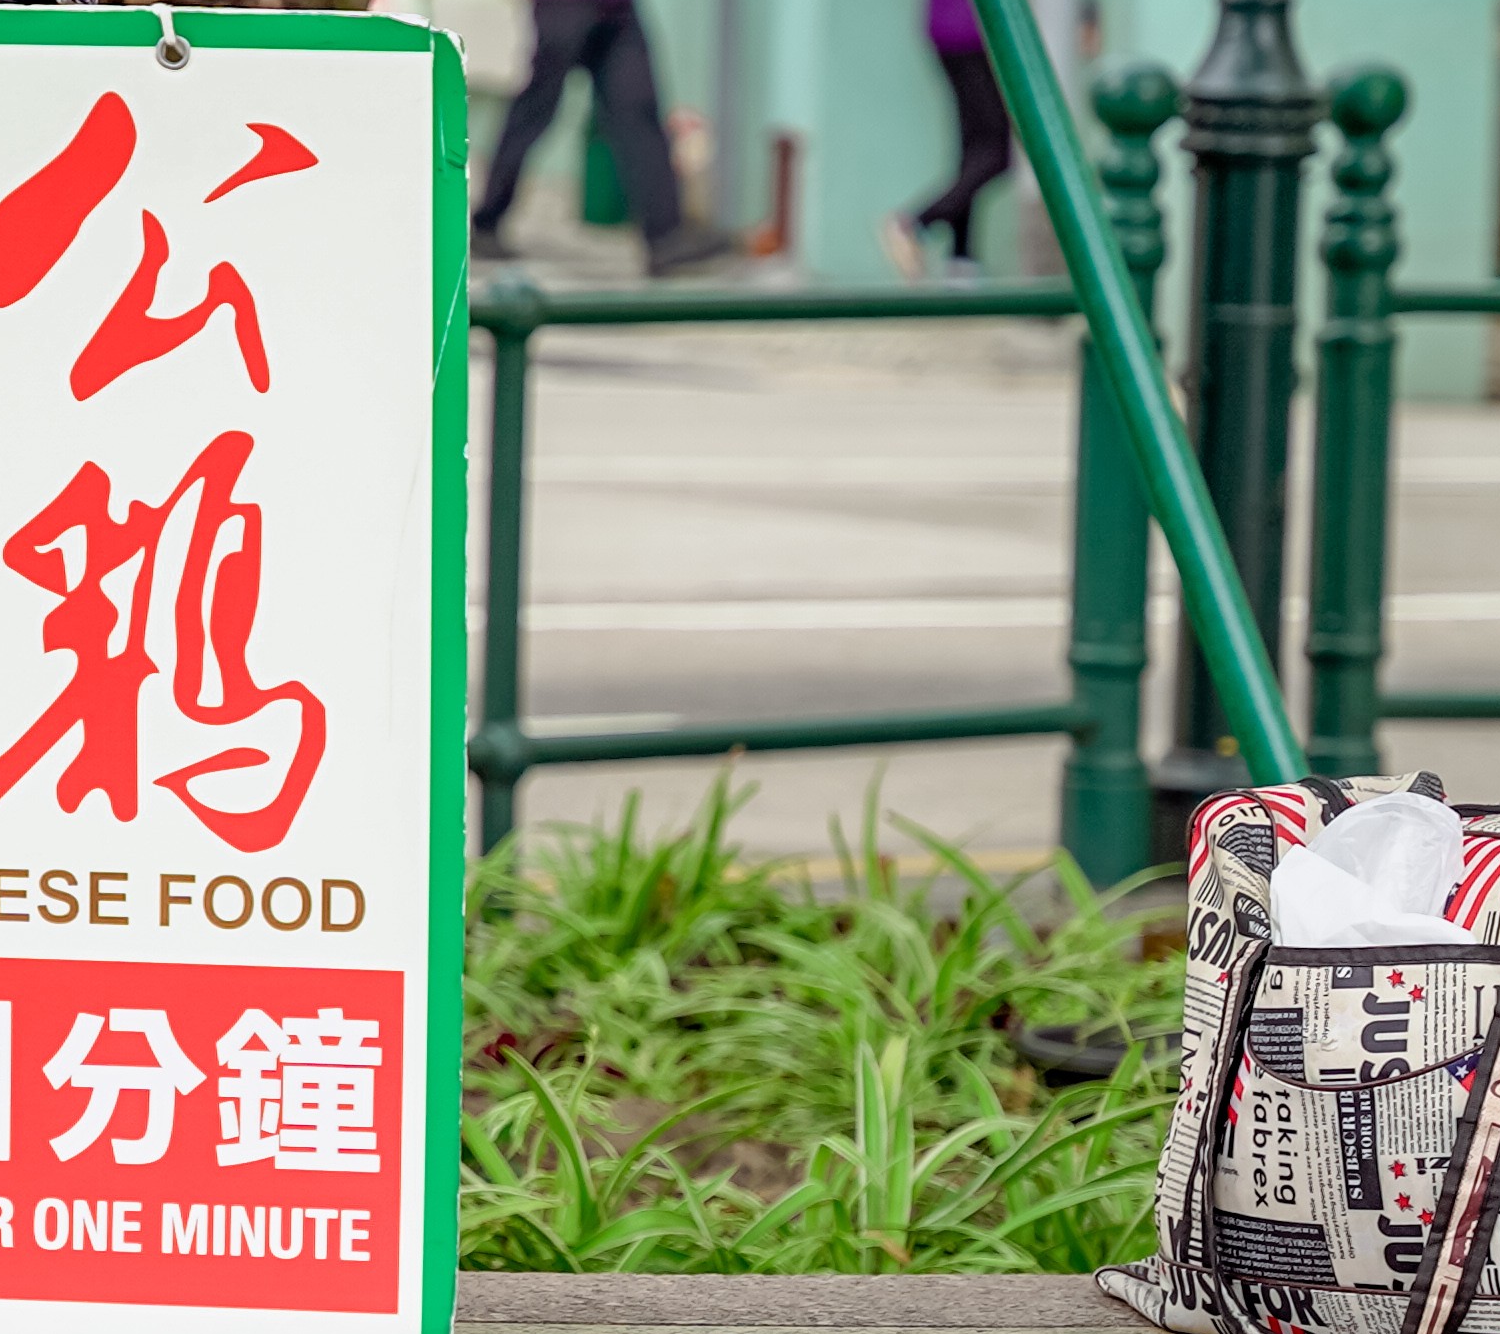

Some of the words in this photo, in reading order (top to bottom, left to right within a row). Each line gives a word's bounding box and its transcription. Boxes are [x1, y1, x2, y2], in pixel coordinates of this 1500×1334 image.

[158, 873, 366, 933] FOOD
[1253, 1090, 1271, 1207] fabrex
[1276, 1090, 1297, 1205] taking
[1361, 1116, 1373, 1160] MORE
[33, 1198, 142, 1253] ONE
[161, 1202, 371, 1262] MINUTE
